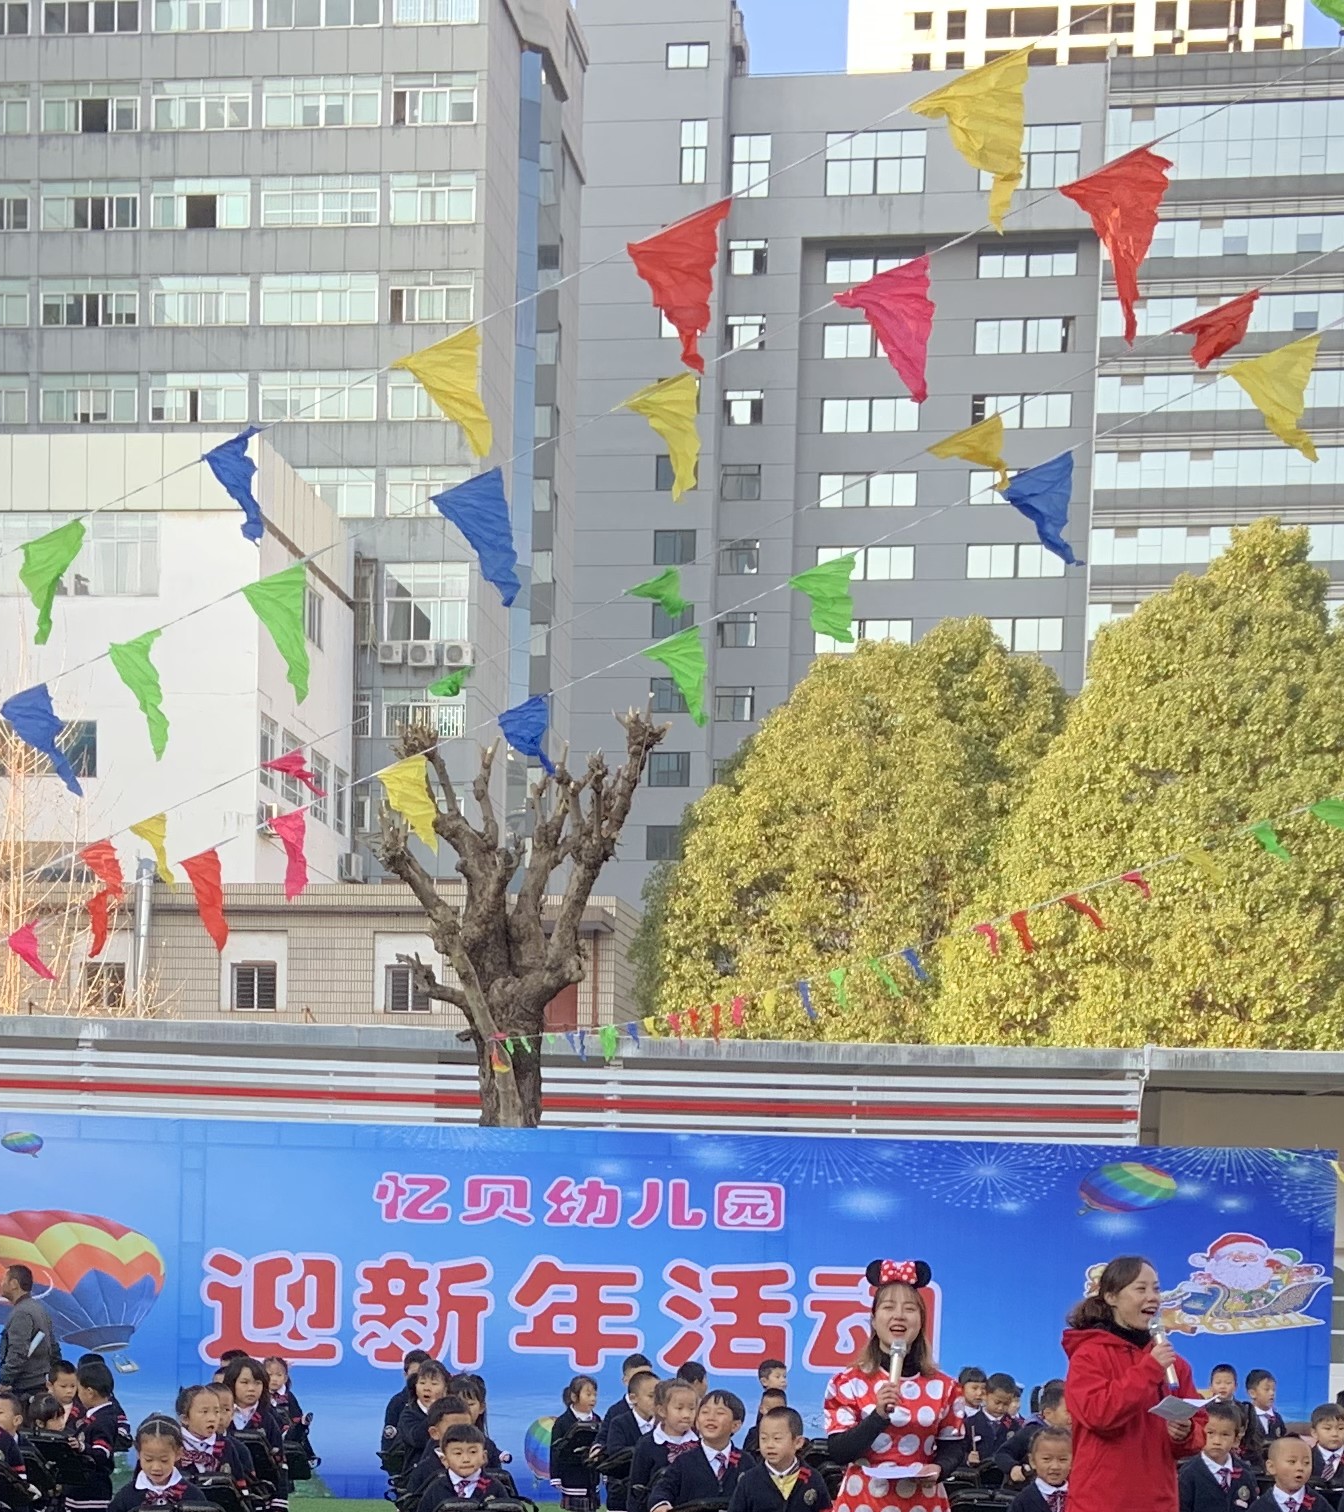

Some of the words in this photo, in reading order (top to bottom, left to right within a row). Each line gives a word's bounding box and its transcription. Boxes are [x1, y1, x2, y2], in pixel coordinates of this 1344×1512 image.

[374, 1172, 785, 1231] 忆贝幼儿园
